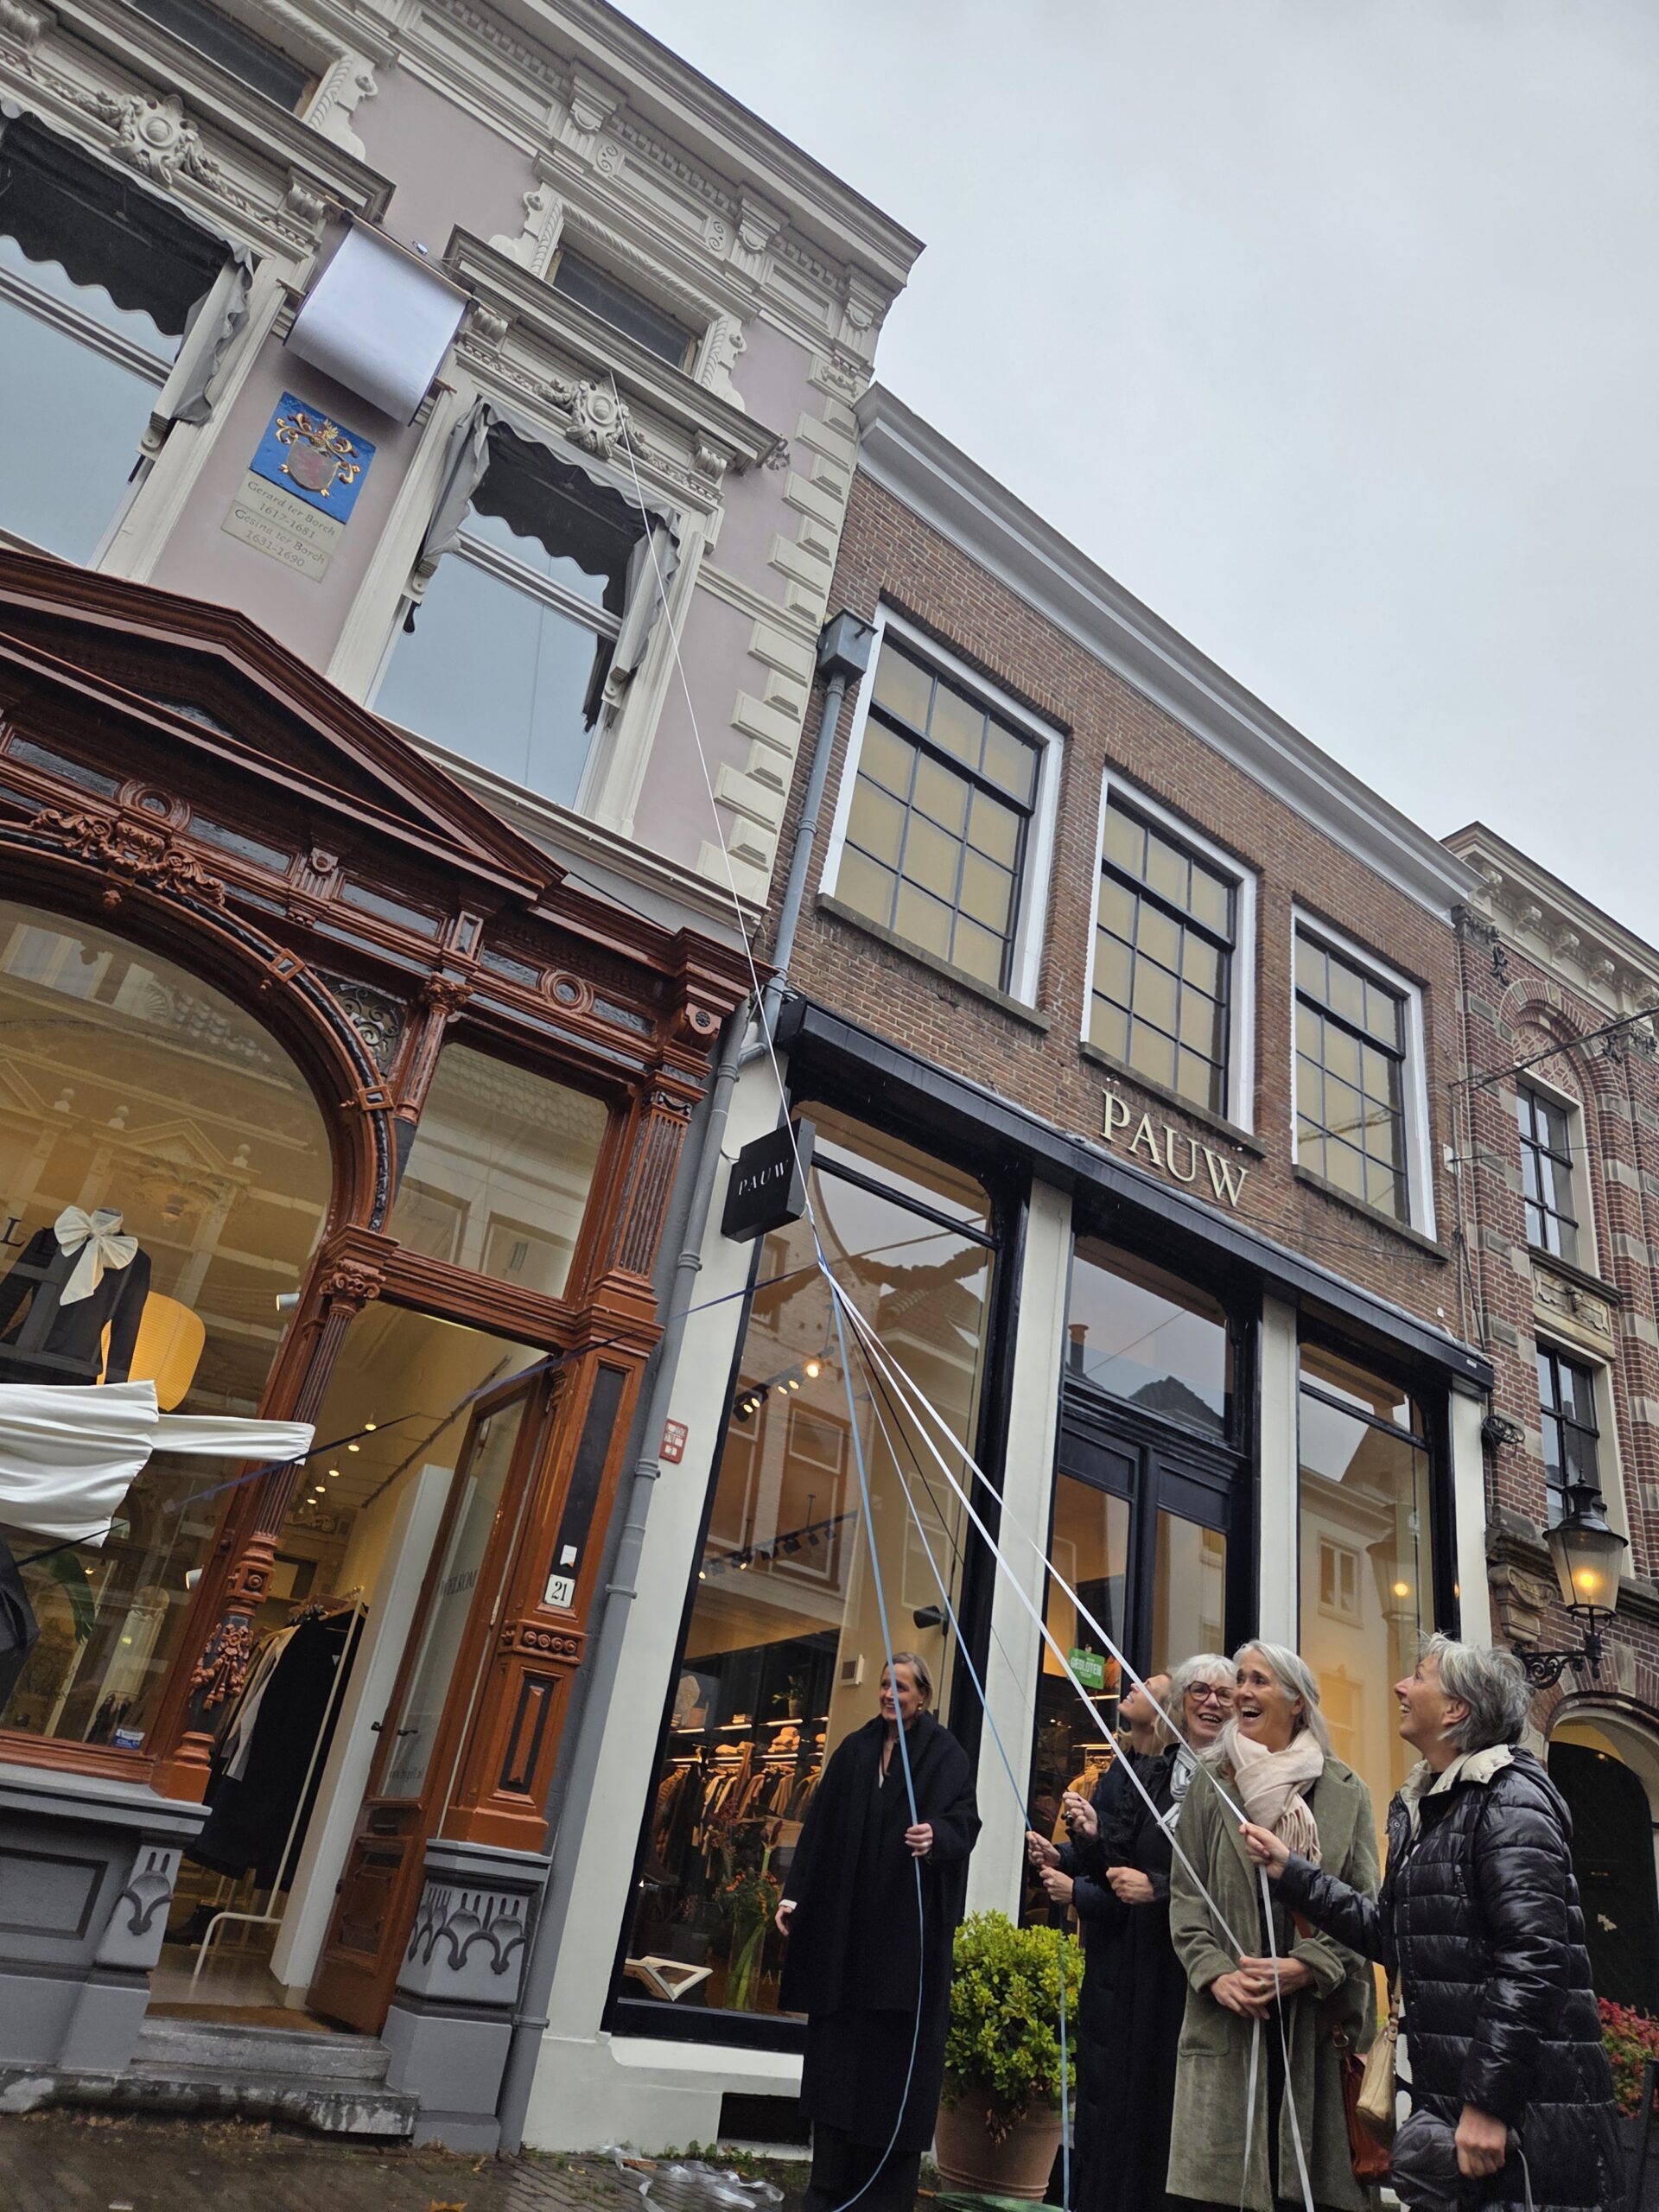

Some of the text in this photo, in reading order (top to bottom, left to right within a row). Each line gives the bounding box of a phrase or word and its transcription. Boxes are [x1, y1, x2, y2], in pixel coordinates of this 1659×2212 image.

[247, 480, 336, 537] Gerard ter Borch
[259, 503, 315, 539] 1617-1681
[234, 508, 326, 564] Gesina ter Borch
[245, 530, 306, 567] 1631-1690
[1099, 1089, 1249, 1208] PAUW
[739, 1160, 789, 1196] PAUW
[551, 1580, 568, 1602] 21
